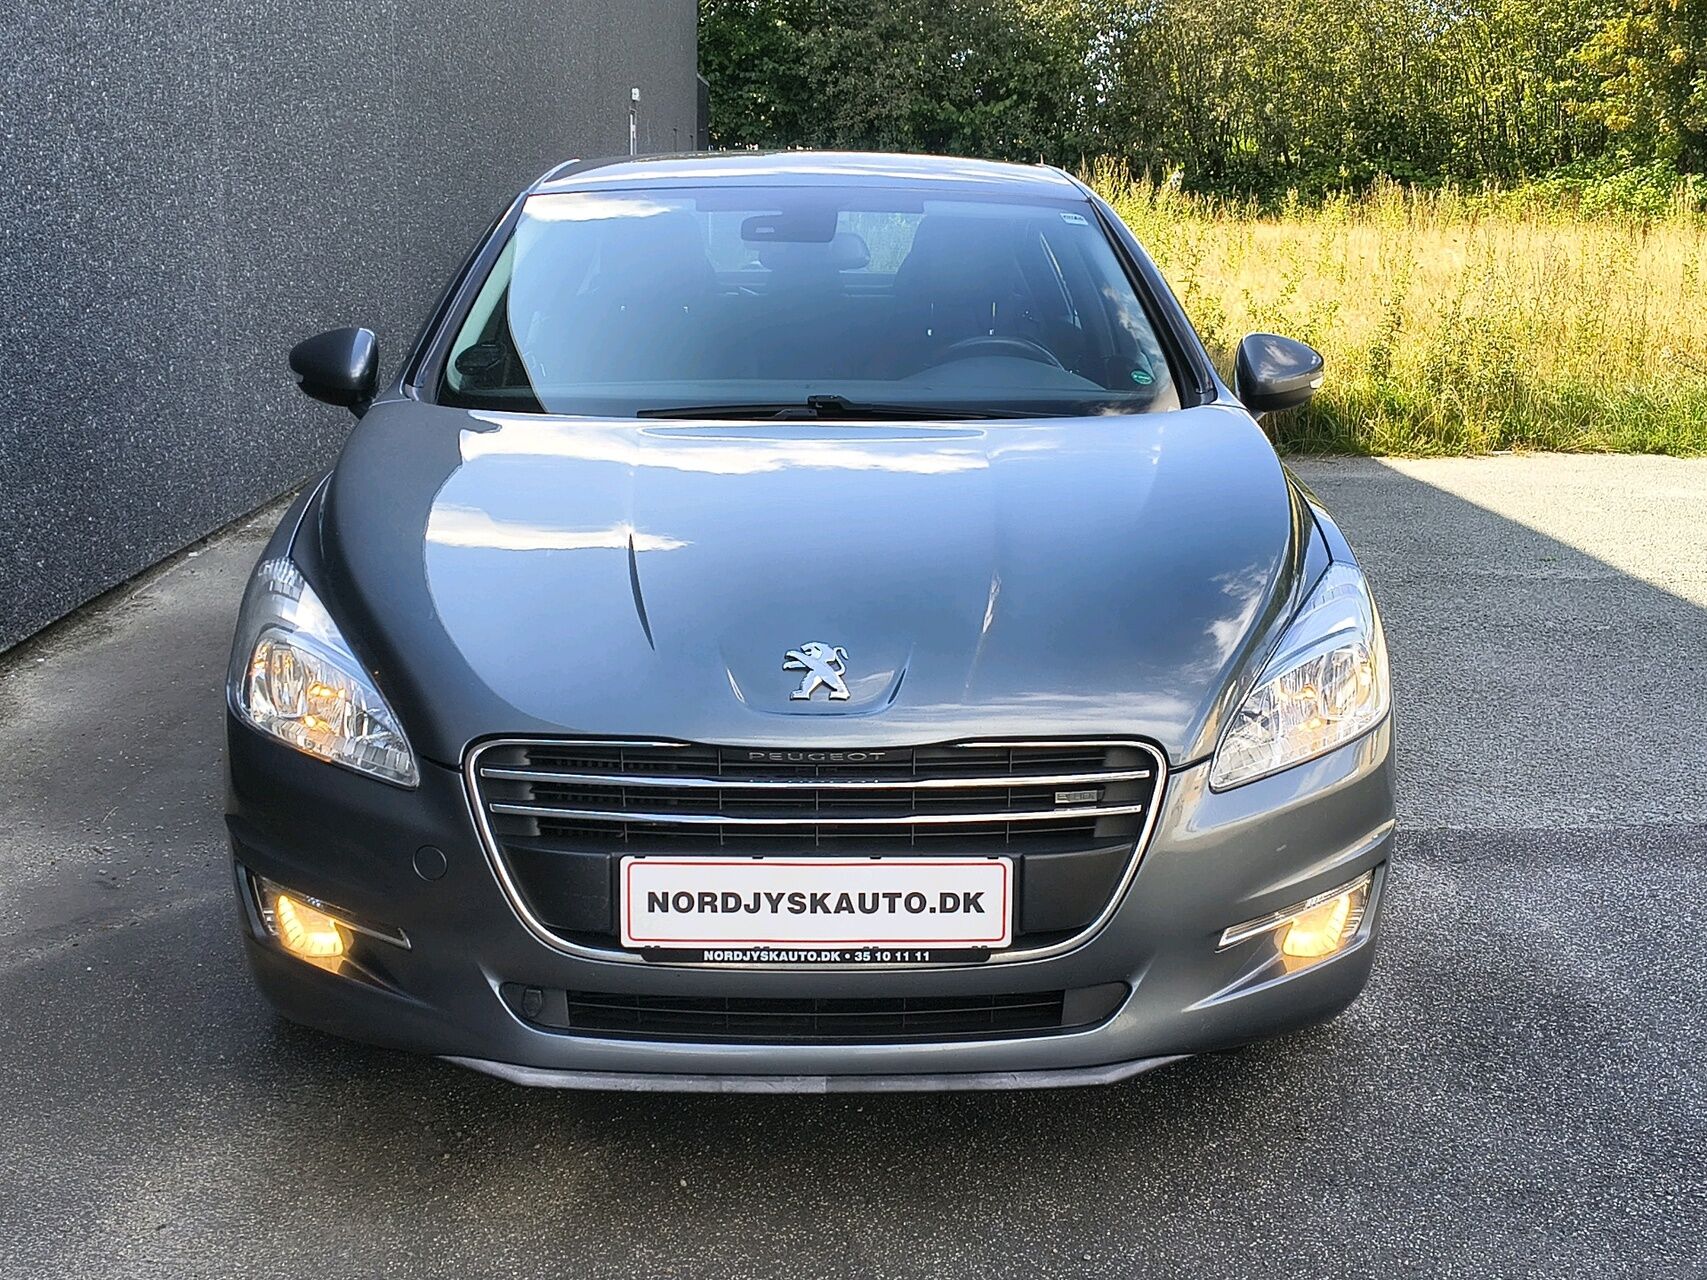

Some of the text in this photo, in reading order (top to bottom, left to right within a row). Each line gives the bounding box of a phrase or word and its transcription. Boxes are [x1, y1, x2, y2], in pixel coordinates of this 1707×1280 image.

[749, 752, 886, 761] PEUGEOT
[647, 891, 985, 915] NORDJYSKAUTO.DK
[703, 950, 930, 962] NORDJYSKAUTO.DK 35 10 11 11
